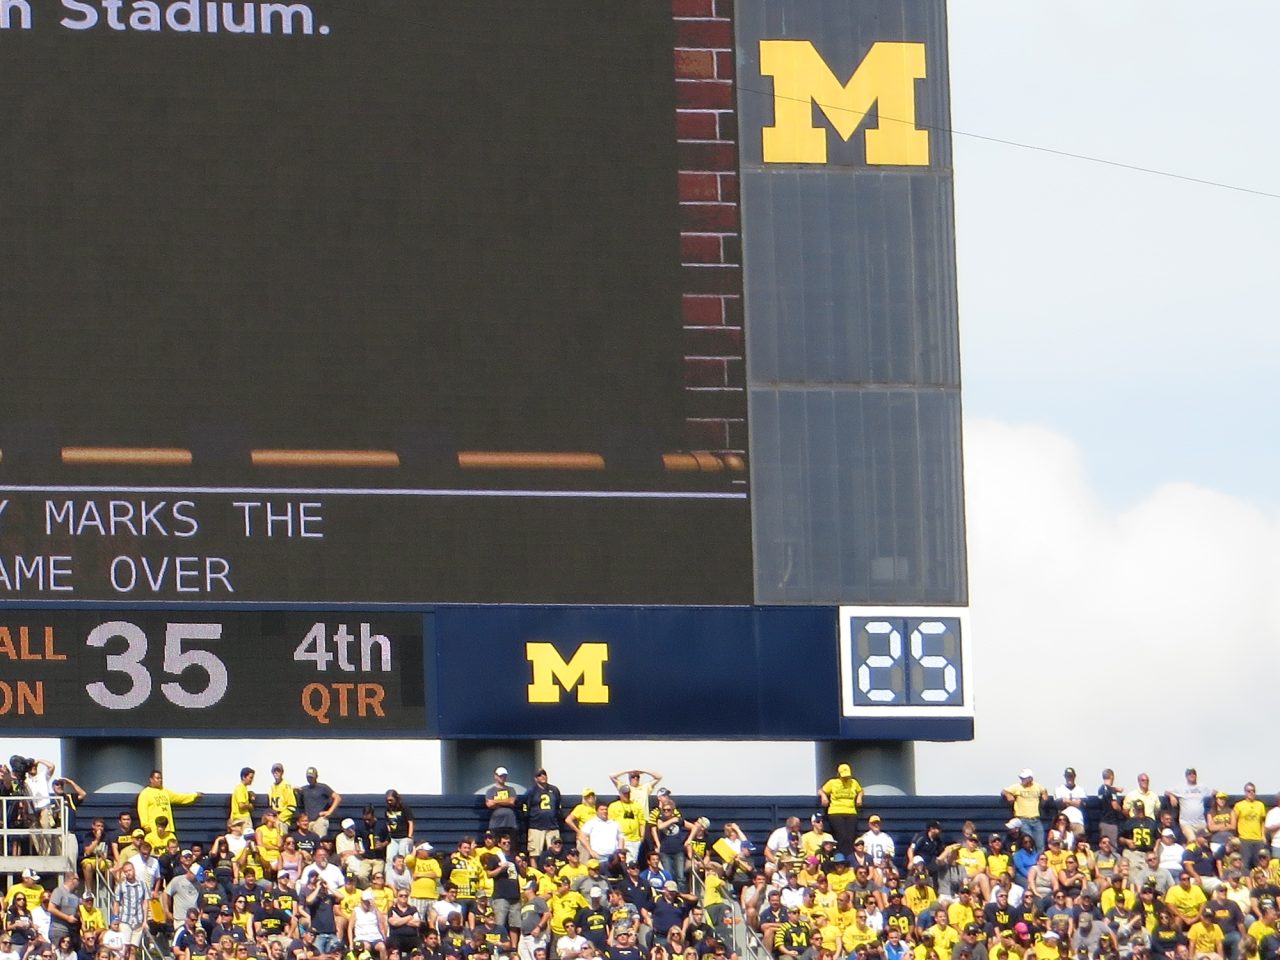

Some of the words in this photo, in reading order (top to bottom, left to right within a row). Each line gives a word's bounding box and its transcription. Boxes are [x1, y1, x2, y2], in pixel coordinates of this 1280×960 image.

[761, 40, 929, 166] M
[45, 500, 199, 537] MARKS
[232, 501, 324, 538] THE
[110, 555, 235, 593] OVER
[85, 620, 229, 711] 35
[293, 622, 392, 672] 4th
[857, 620, 957, 702] 25
[525, 641, 610, 703] M
[301, 682, 386, 724] QTR
[539, 793, 552, 811] 2
[791, 931, 808, 947] M
